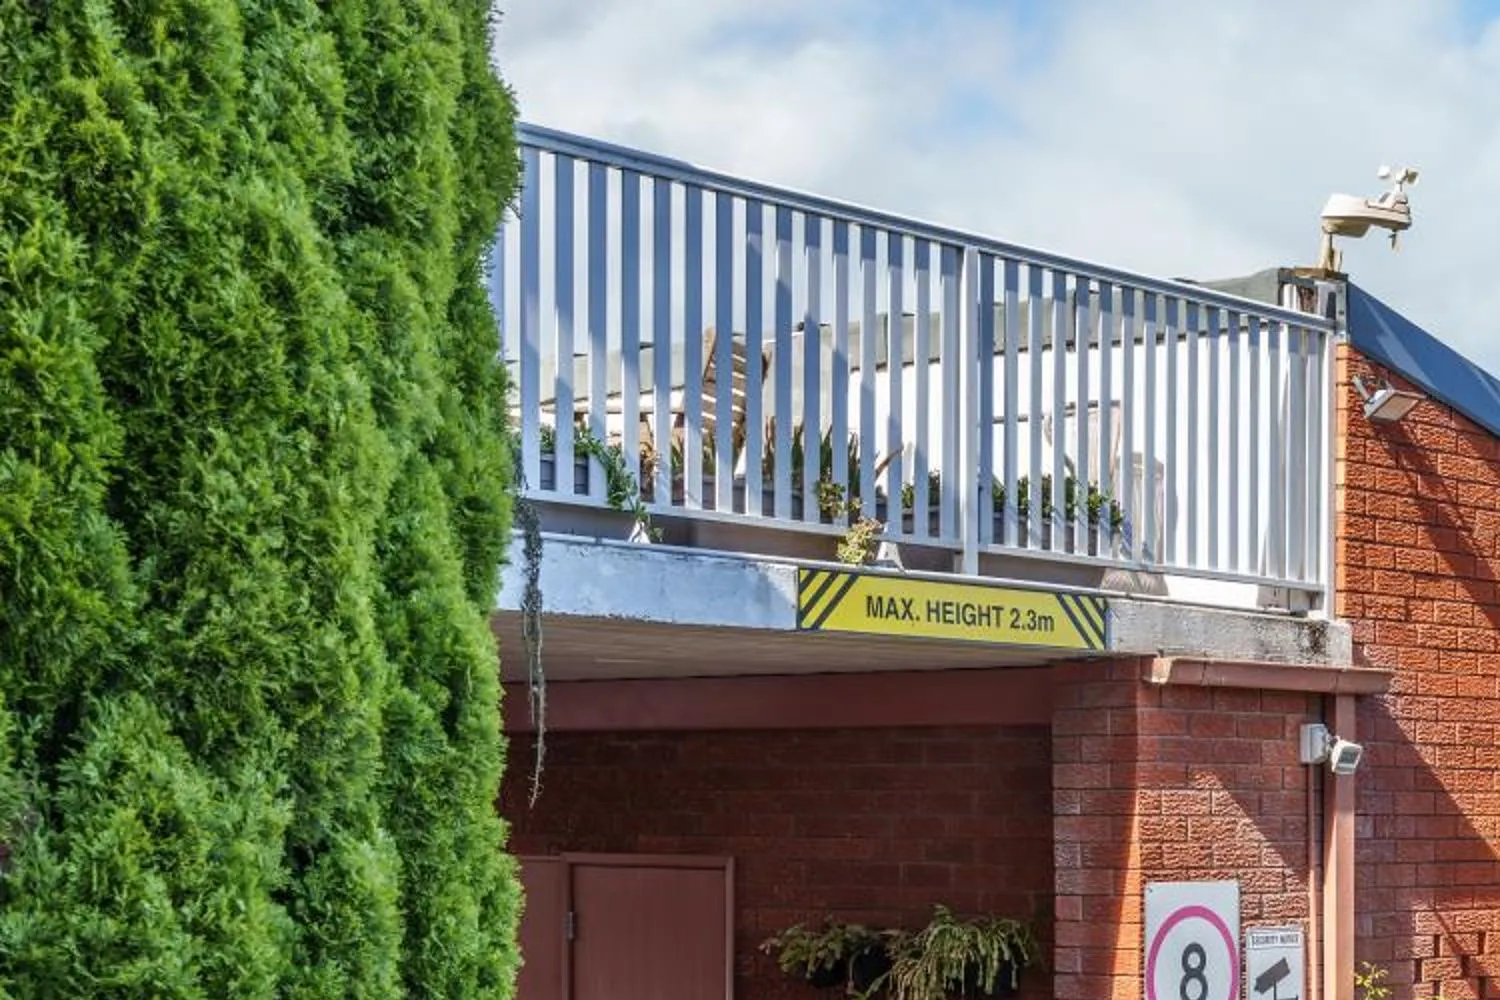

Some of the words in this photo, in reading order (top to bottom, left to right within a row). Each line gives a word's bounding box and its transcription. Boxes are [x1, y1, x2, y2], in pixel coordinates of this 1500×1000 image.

[866, 596, 919, 621] MAX.
[927, 600, 1005, 627] HEIGHT
[1010, 608, 1054, 632] 2.3m
